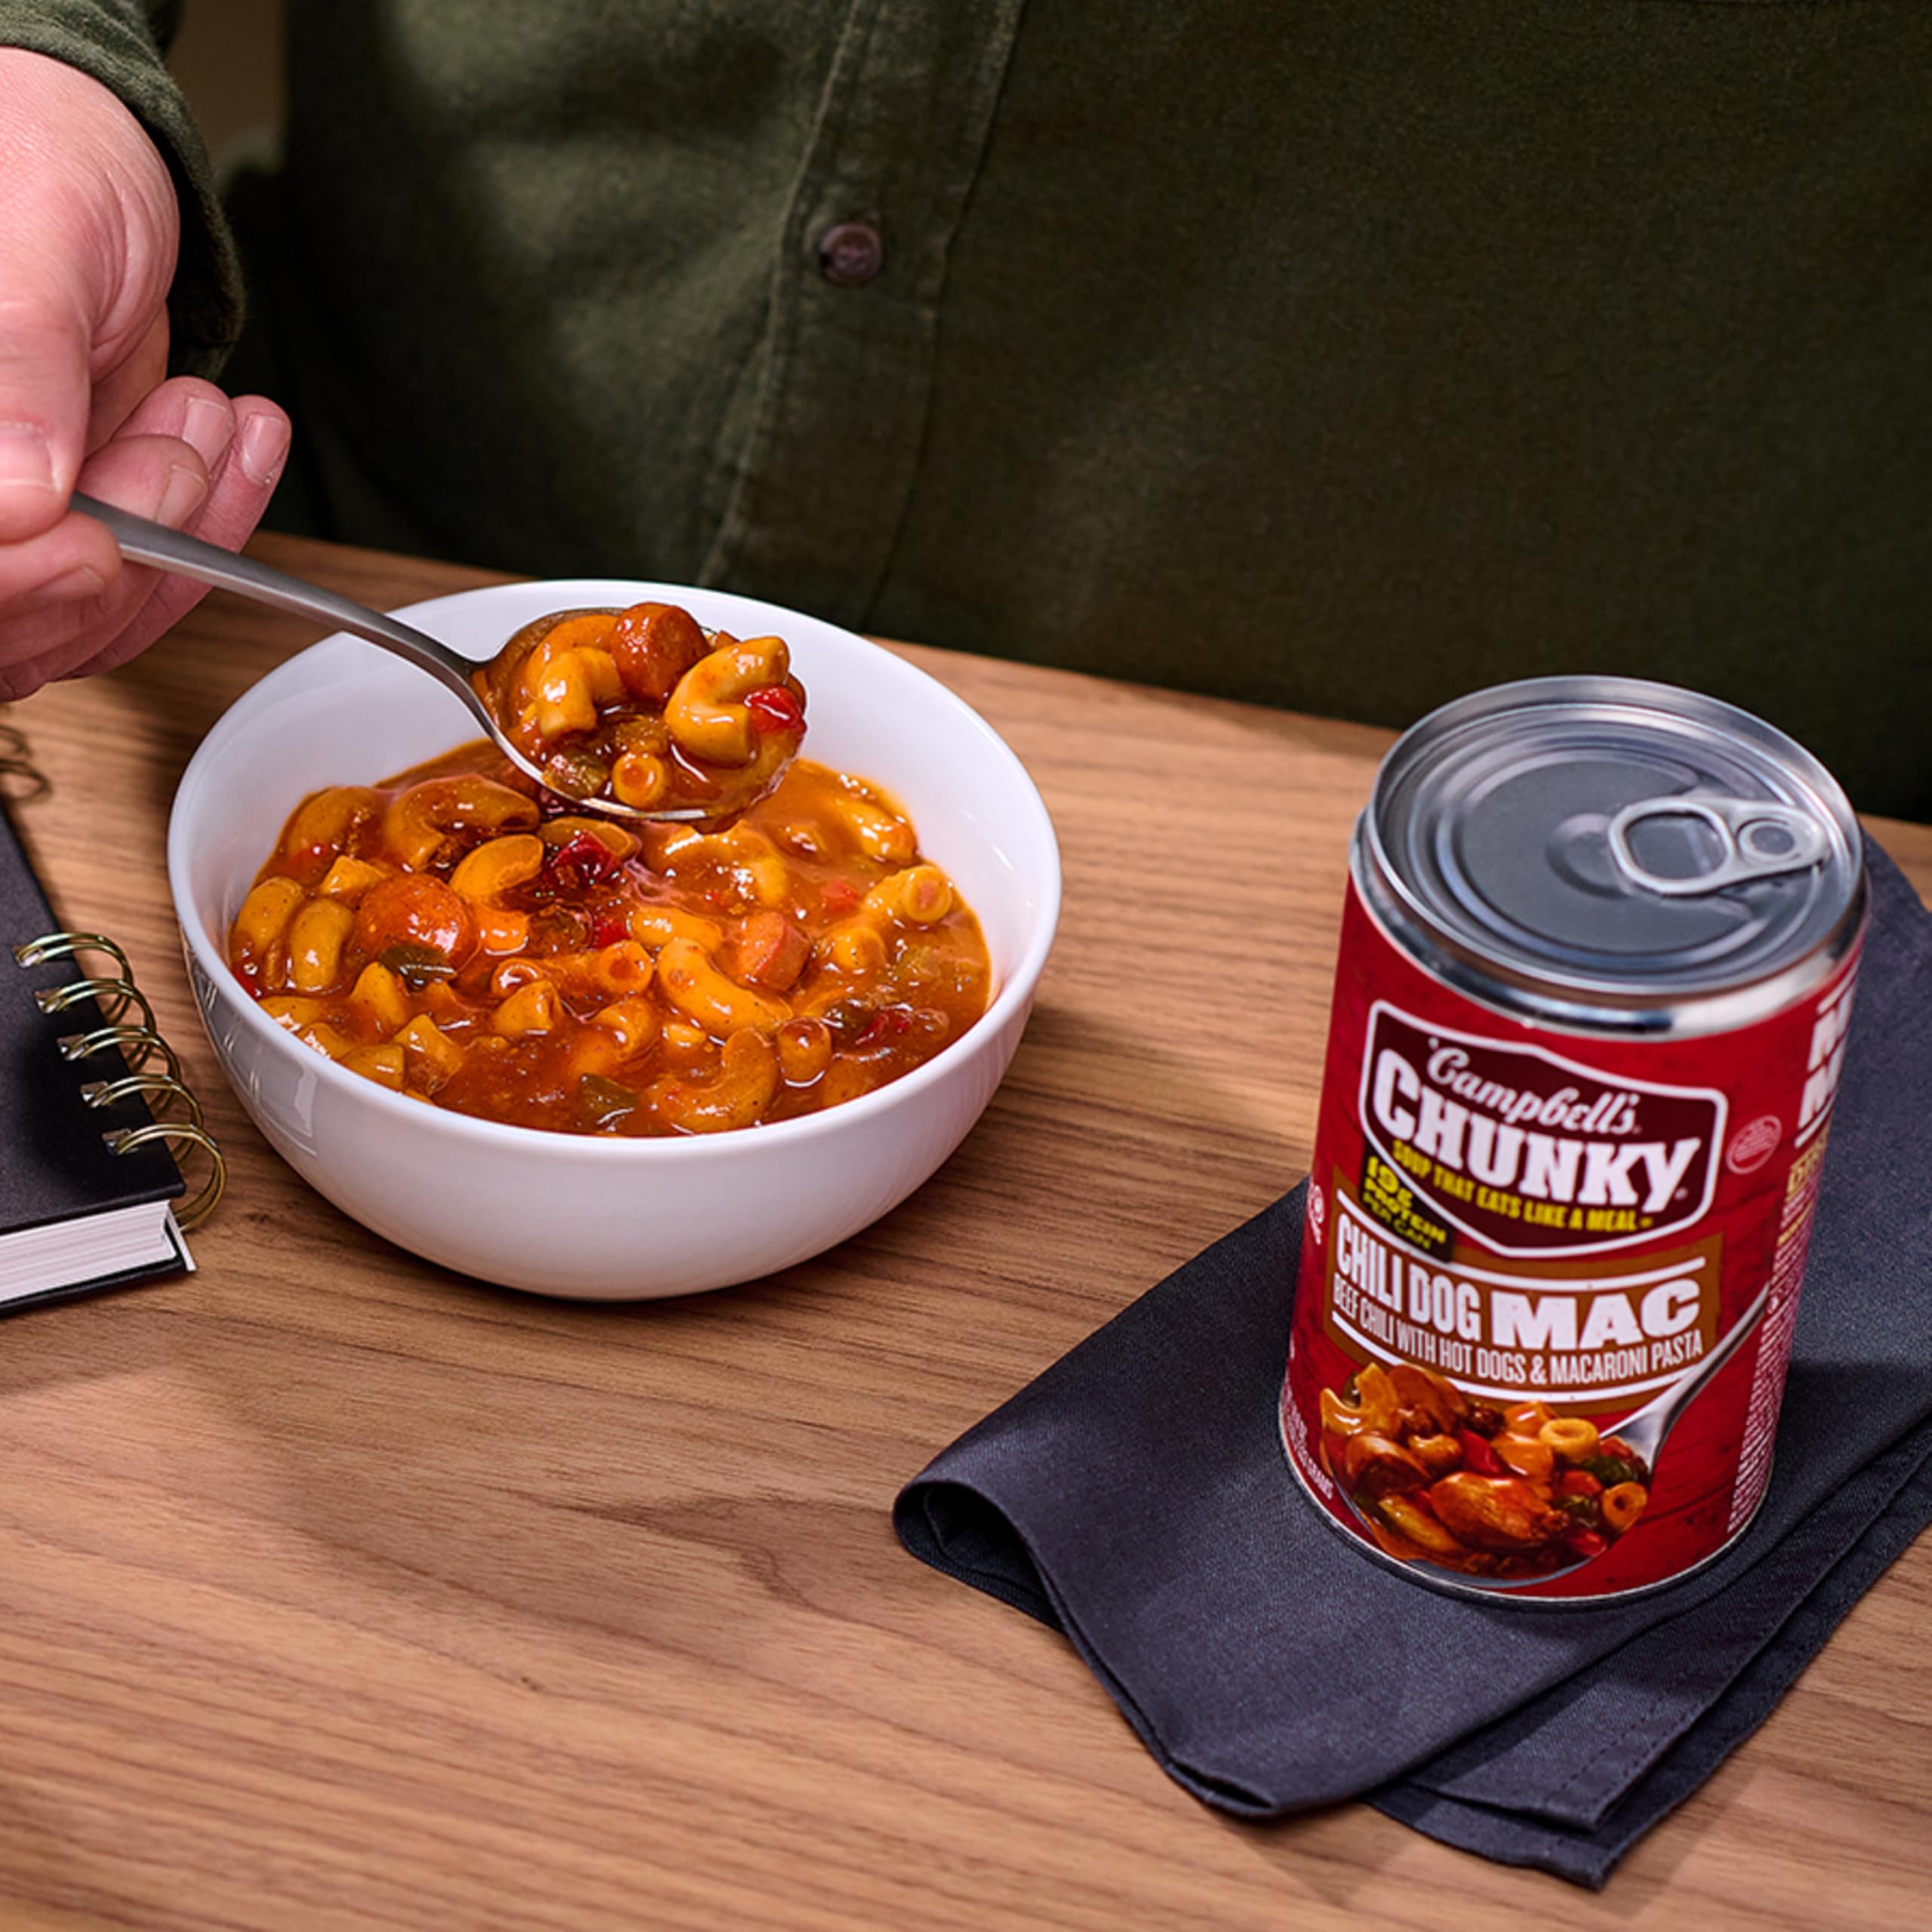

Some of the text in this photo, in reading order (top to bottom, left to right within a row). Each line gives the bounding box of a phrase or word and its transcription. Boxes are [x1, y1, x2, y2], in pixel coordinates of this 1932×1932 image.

[1373, 1048, 1702, 1214] CHUNKY
[1427, 1037, 1641, 1134] Campbell's
[1392, 1140, 1432, 1179] SOUP
[1433, 1165, 1474, 1202] THAT
[1476, 1185, 1522, 1220] EATS
[1523, 1200, 1567, 1229] LIKE
[1568, 1208, 1583, 1230] A
[1332, 1272, 1703, 1386] BEEF CHILI WITH HOT DOGS & MACARONI PASTA
[1337, 1212, 1403, 1313] CHILI
[1409, 1263, 1481, 1343] DOG
[1491, 1278, 1700, 1351] MAC
